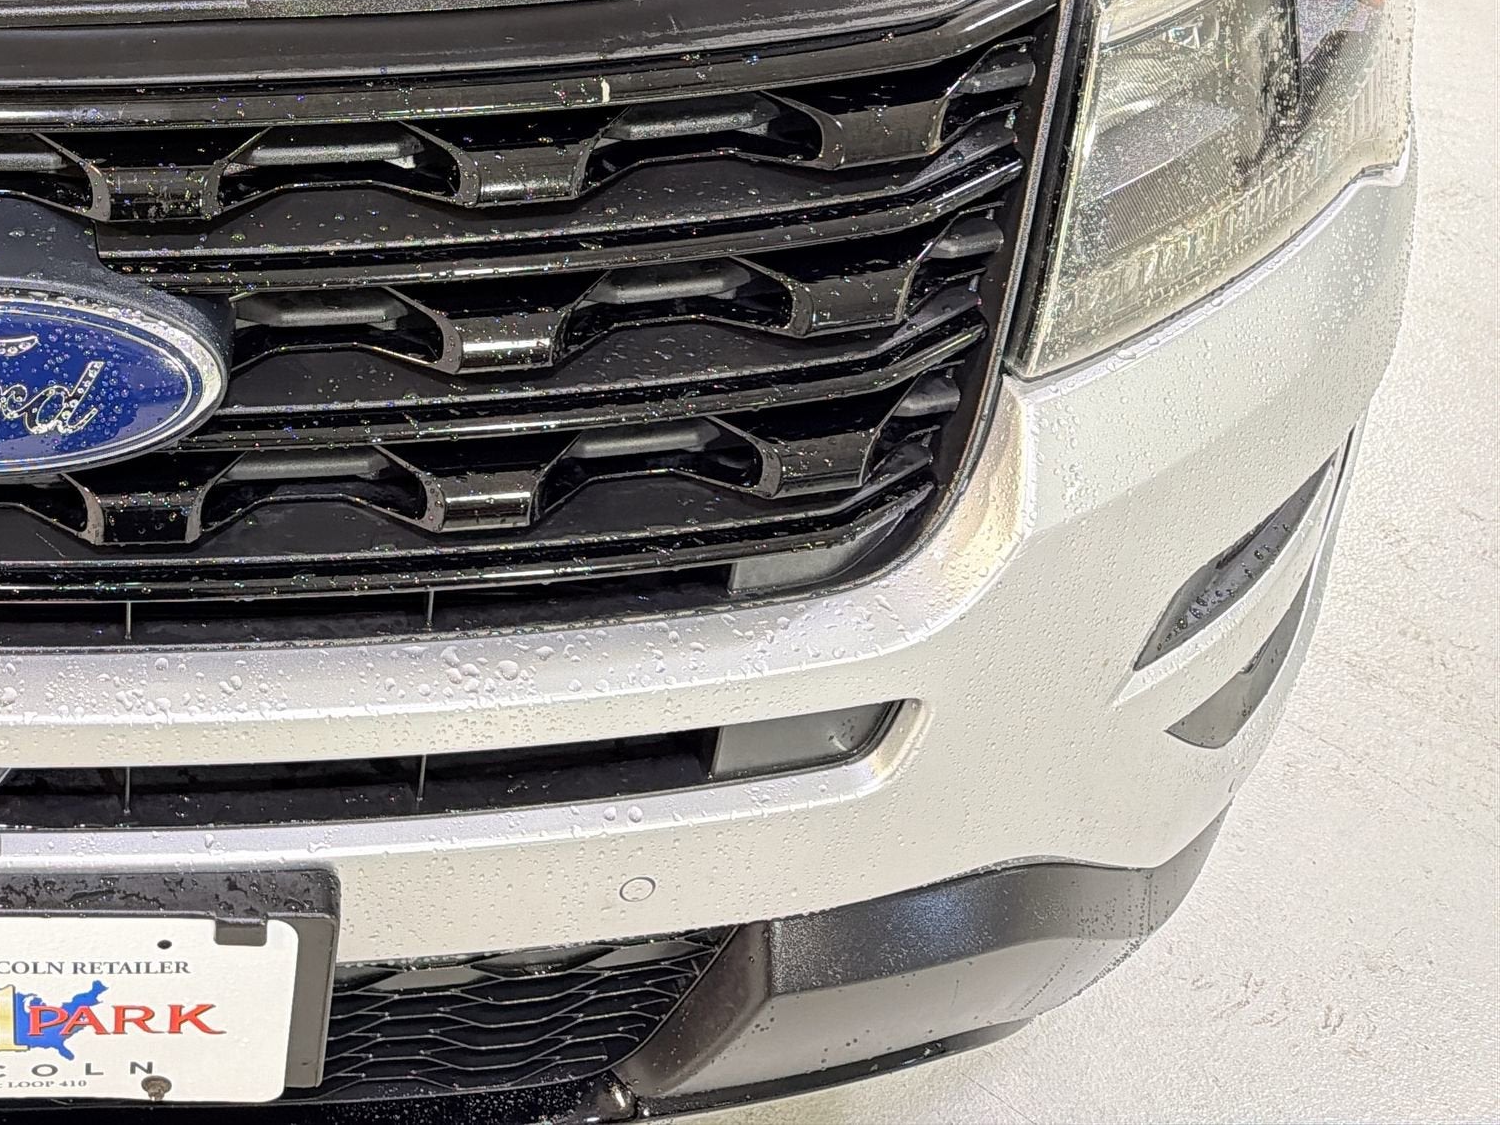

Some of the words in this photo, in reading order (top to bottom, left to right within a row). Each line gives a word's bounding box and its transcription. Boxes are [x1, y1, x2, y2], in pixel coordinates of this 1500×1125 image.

[72, 961, 192, 975] RETAILER
[27, 1003, 228, 1037] PARK
[8, 1080, 55, 1089] LOOP
[59, 1079, 88, 1088] 410
